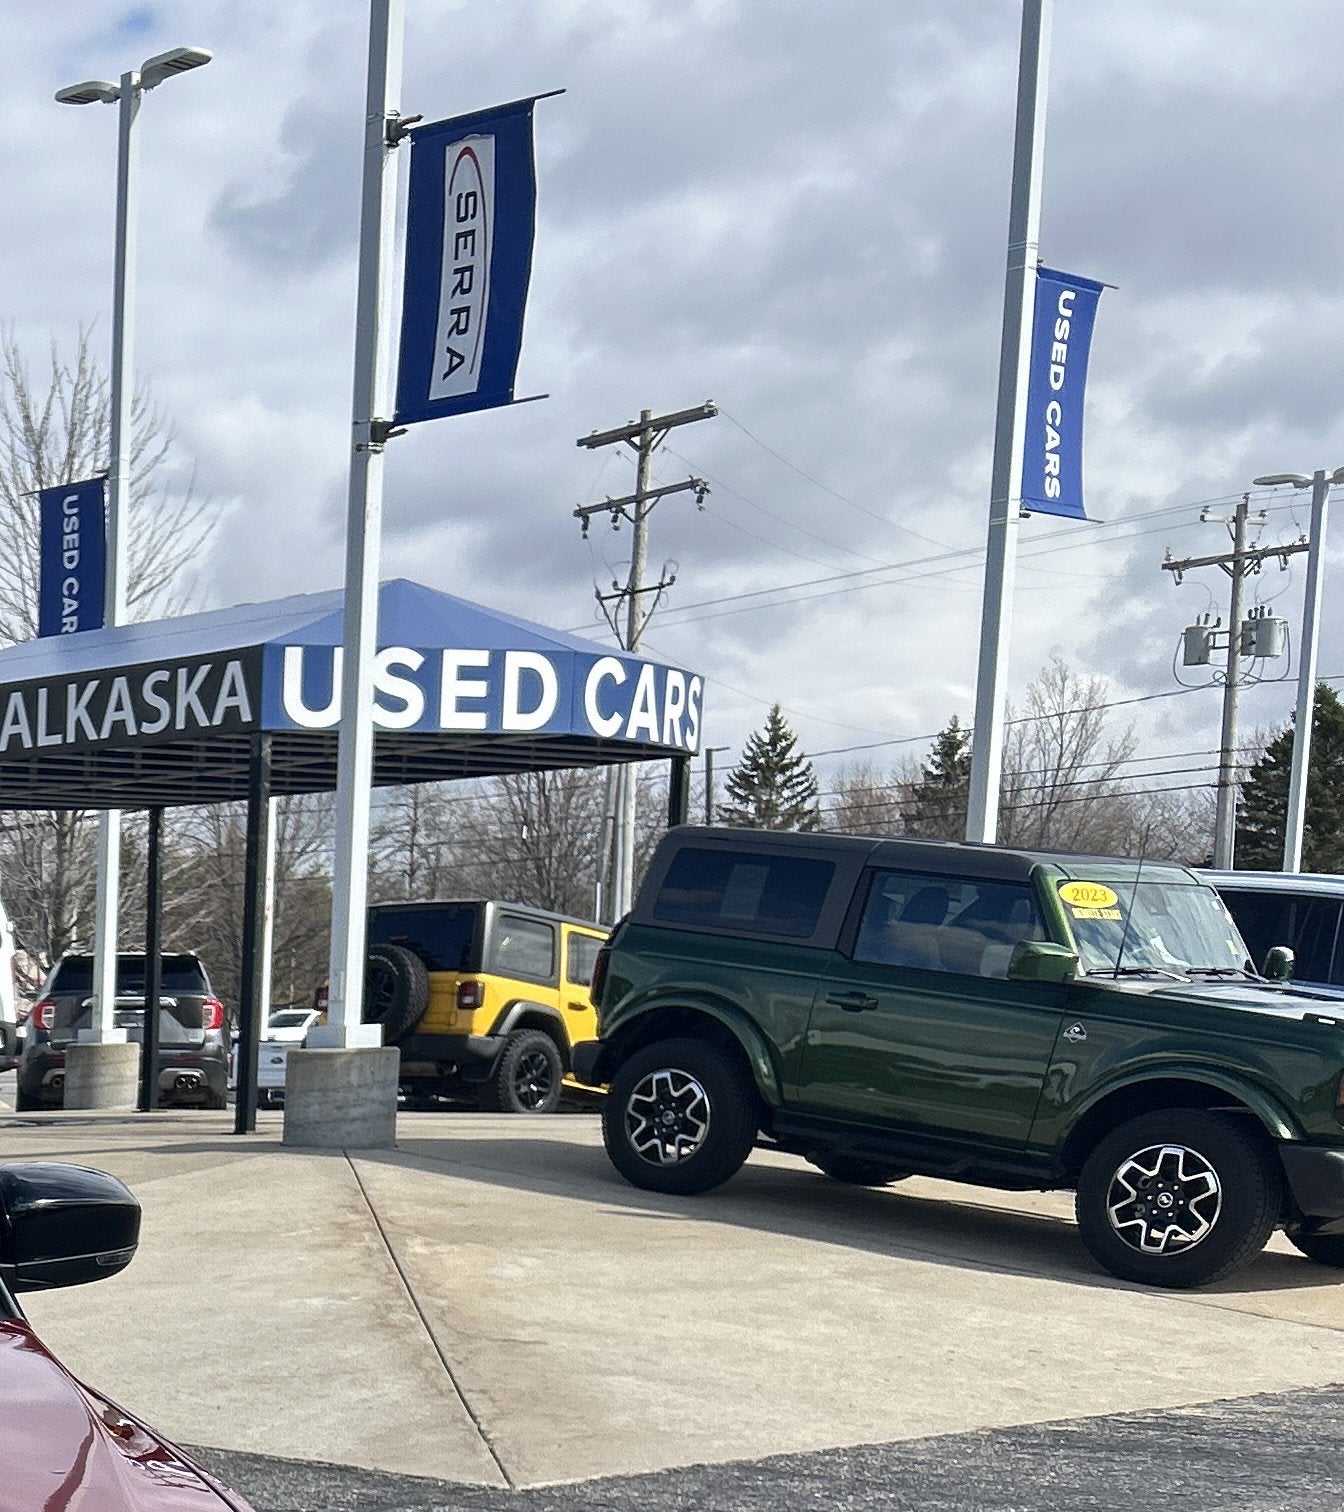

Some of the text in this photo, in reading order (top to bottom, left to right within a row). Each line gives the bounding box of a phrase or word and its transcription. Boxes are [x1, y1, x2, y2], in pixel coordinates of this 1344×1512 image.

[442, 190, 478, 381] SERRA
[1043, 289, 1076, 500] USED CARS
[61, 494, 81, 634] USED CAR
[283, 645, 702, 752] USED CARS
[1071, 887, 1109, 902] 2023
